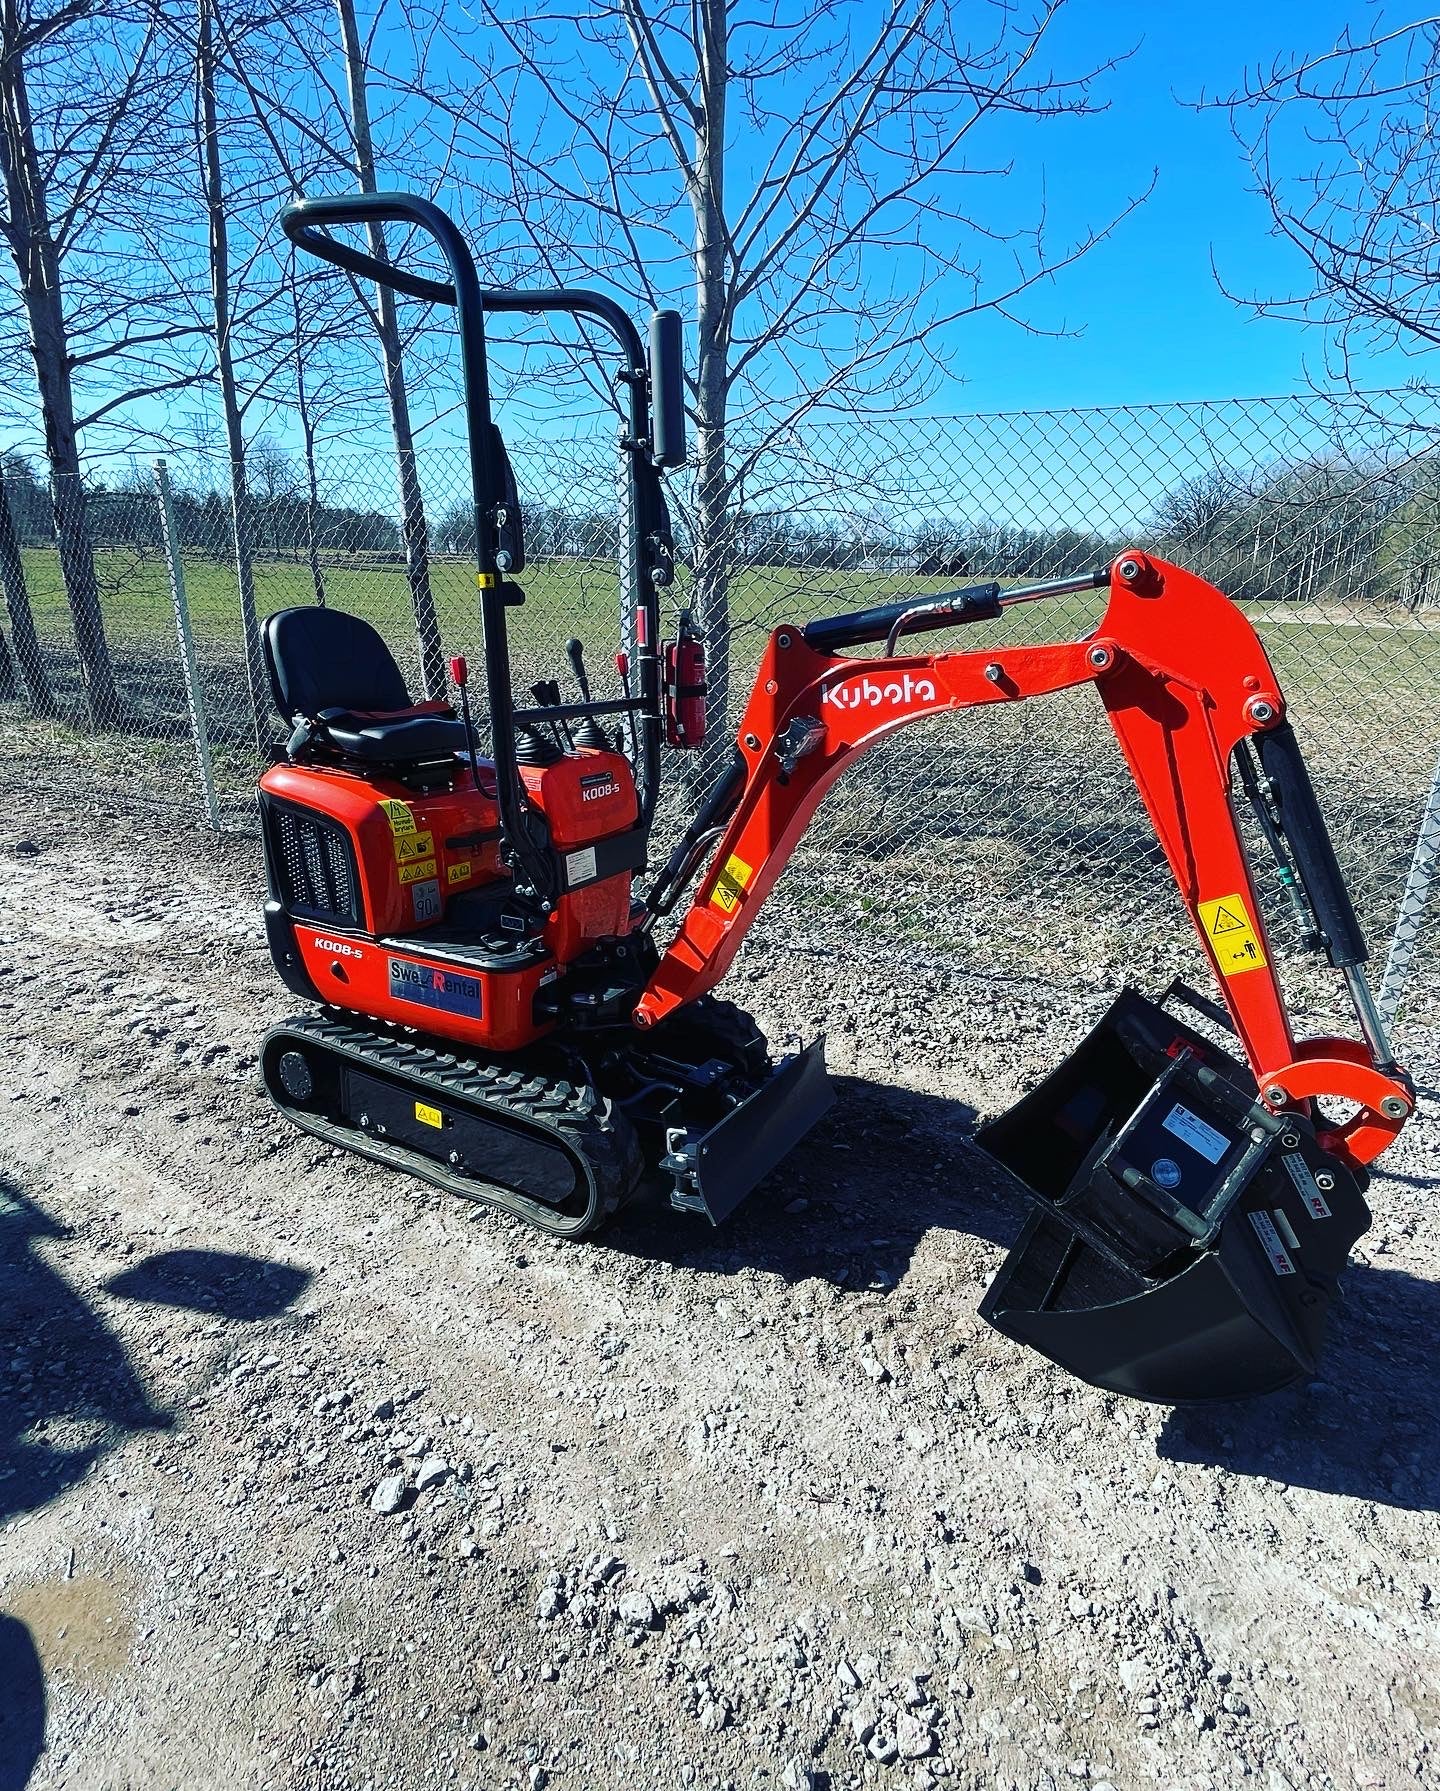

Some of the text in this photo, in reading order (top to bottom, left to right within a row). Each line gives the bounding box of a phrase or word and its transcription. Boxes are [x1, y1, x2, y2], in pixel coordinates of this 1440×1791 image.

[821, 674, 936, 709] Kubota
[582, 783, 620, 802] K008-5
[314, 937, 363, 959] K008-5
[1311, 1197, 1328, 1216] RF
[1275, 1254, 1292, 1273] RF
